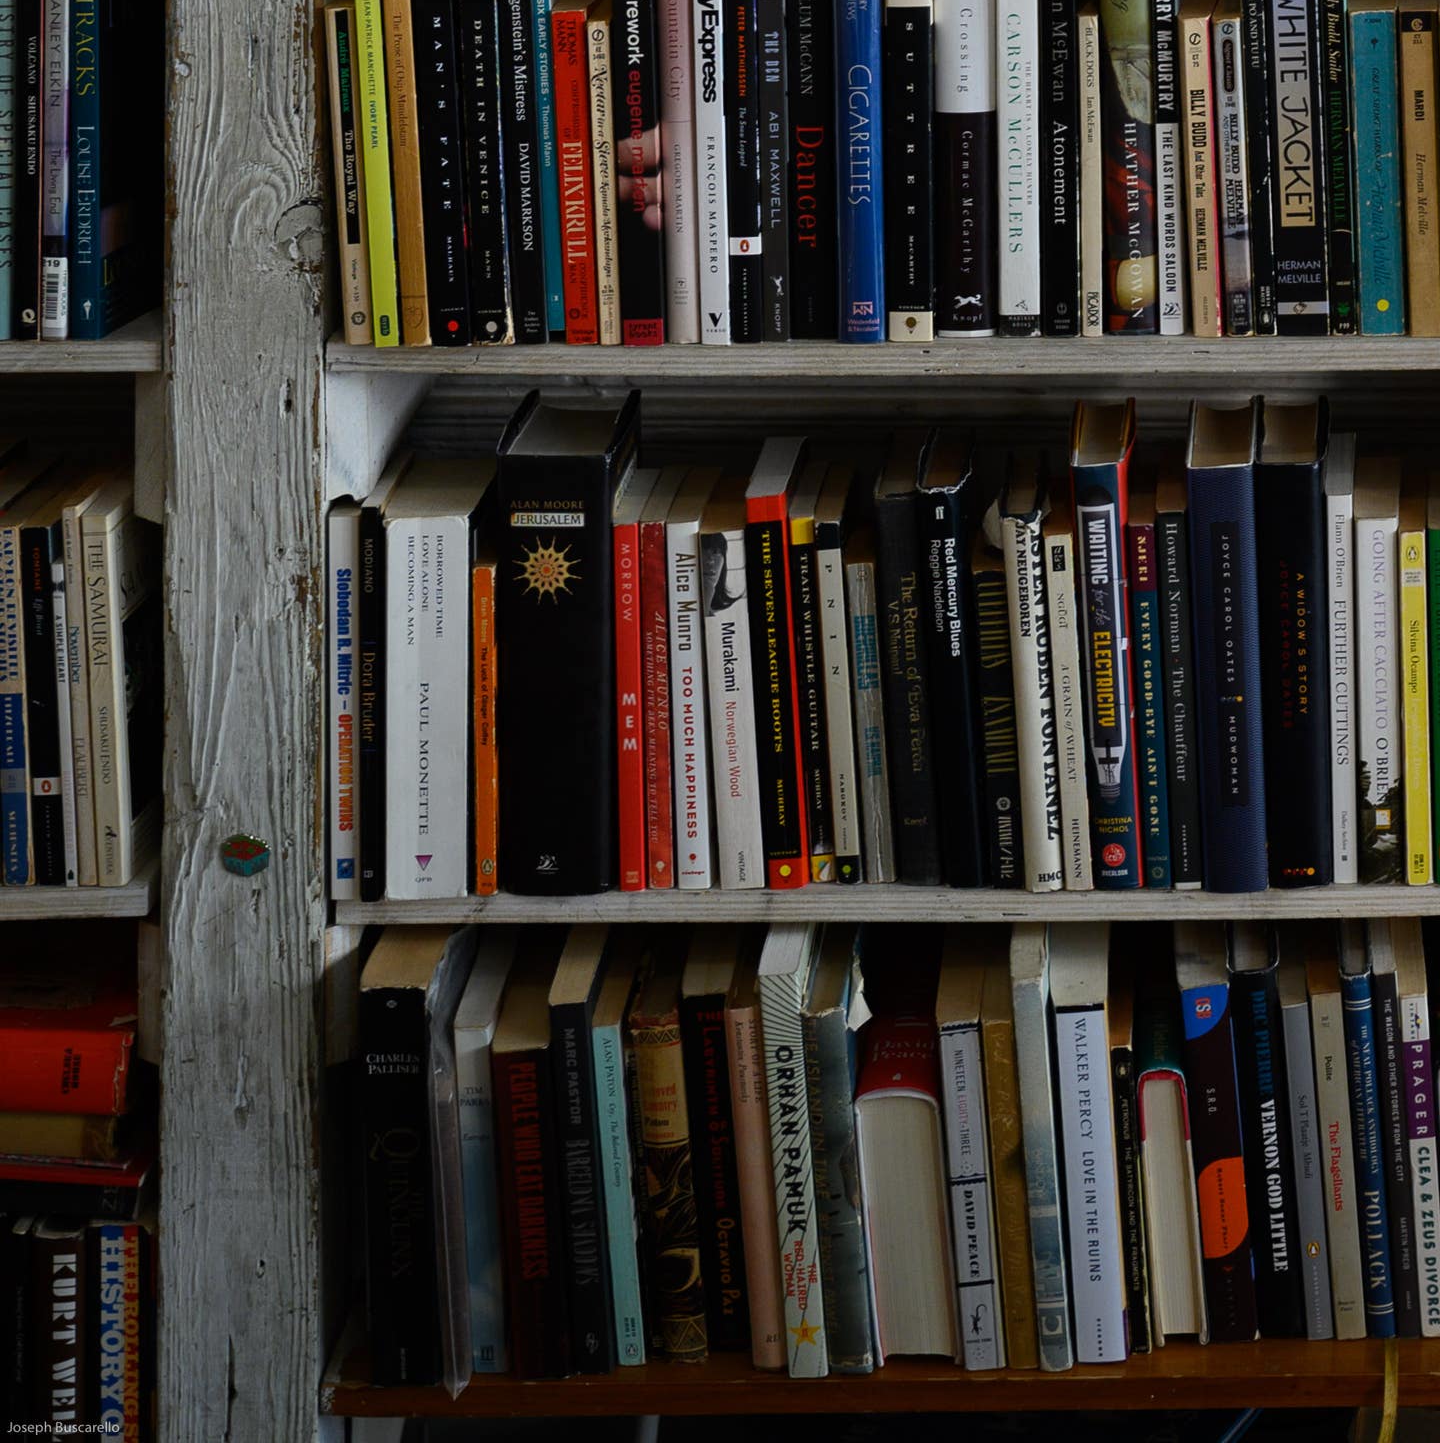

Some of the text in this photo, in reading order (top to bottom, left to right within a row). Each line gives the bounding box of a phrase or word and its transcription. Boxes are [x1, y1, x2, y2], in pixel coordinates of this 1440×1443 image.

[1280, 95, 1315, 223] JACKET
[88, 541, 108, 666] THE SAMURAI
[676, 552, 696, 651] Alice Munro
[1089, 519, 1109, 584] WAITING
[1095, 631, 1118, 727] ELECTRICITY
[419, 683, 430, 834] PAUL MONETTE
[774, 1046, 807, 1233] ORHAN PAMUK
[1364, 1189, 1387, 1289] POLLACK
